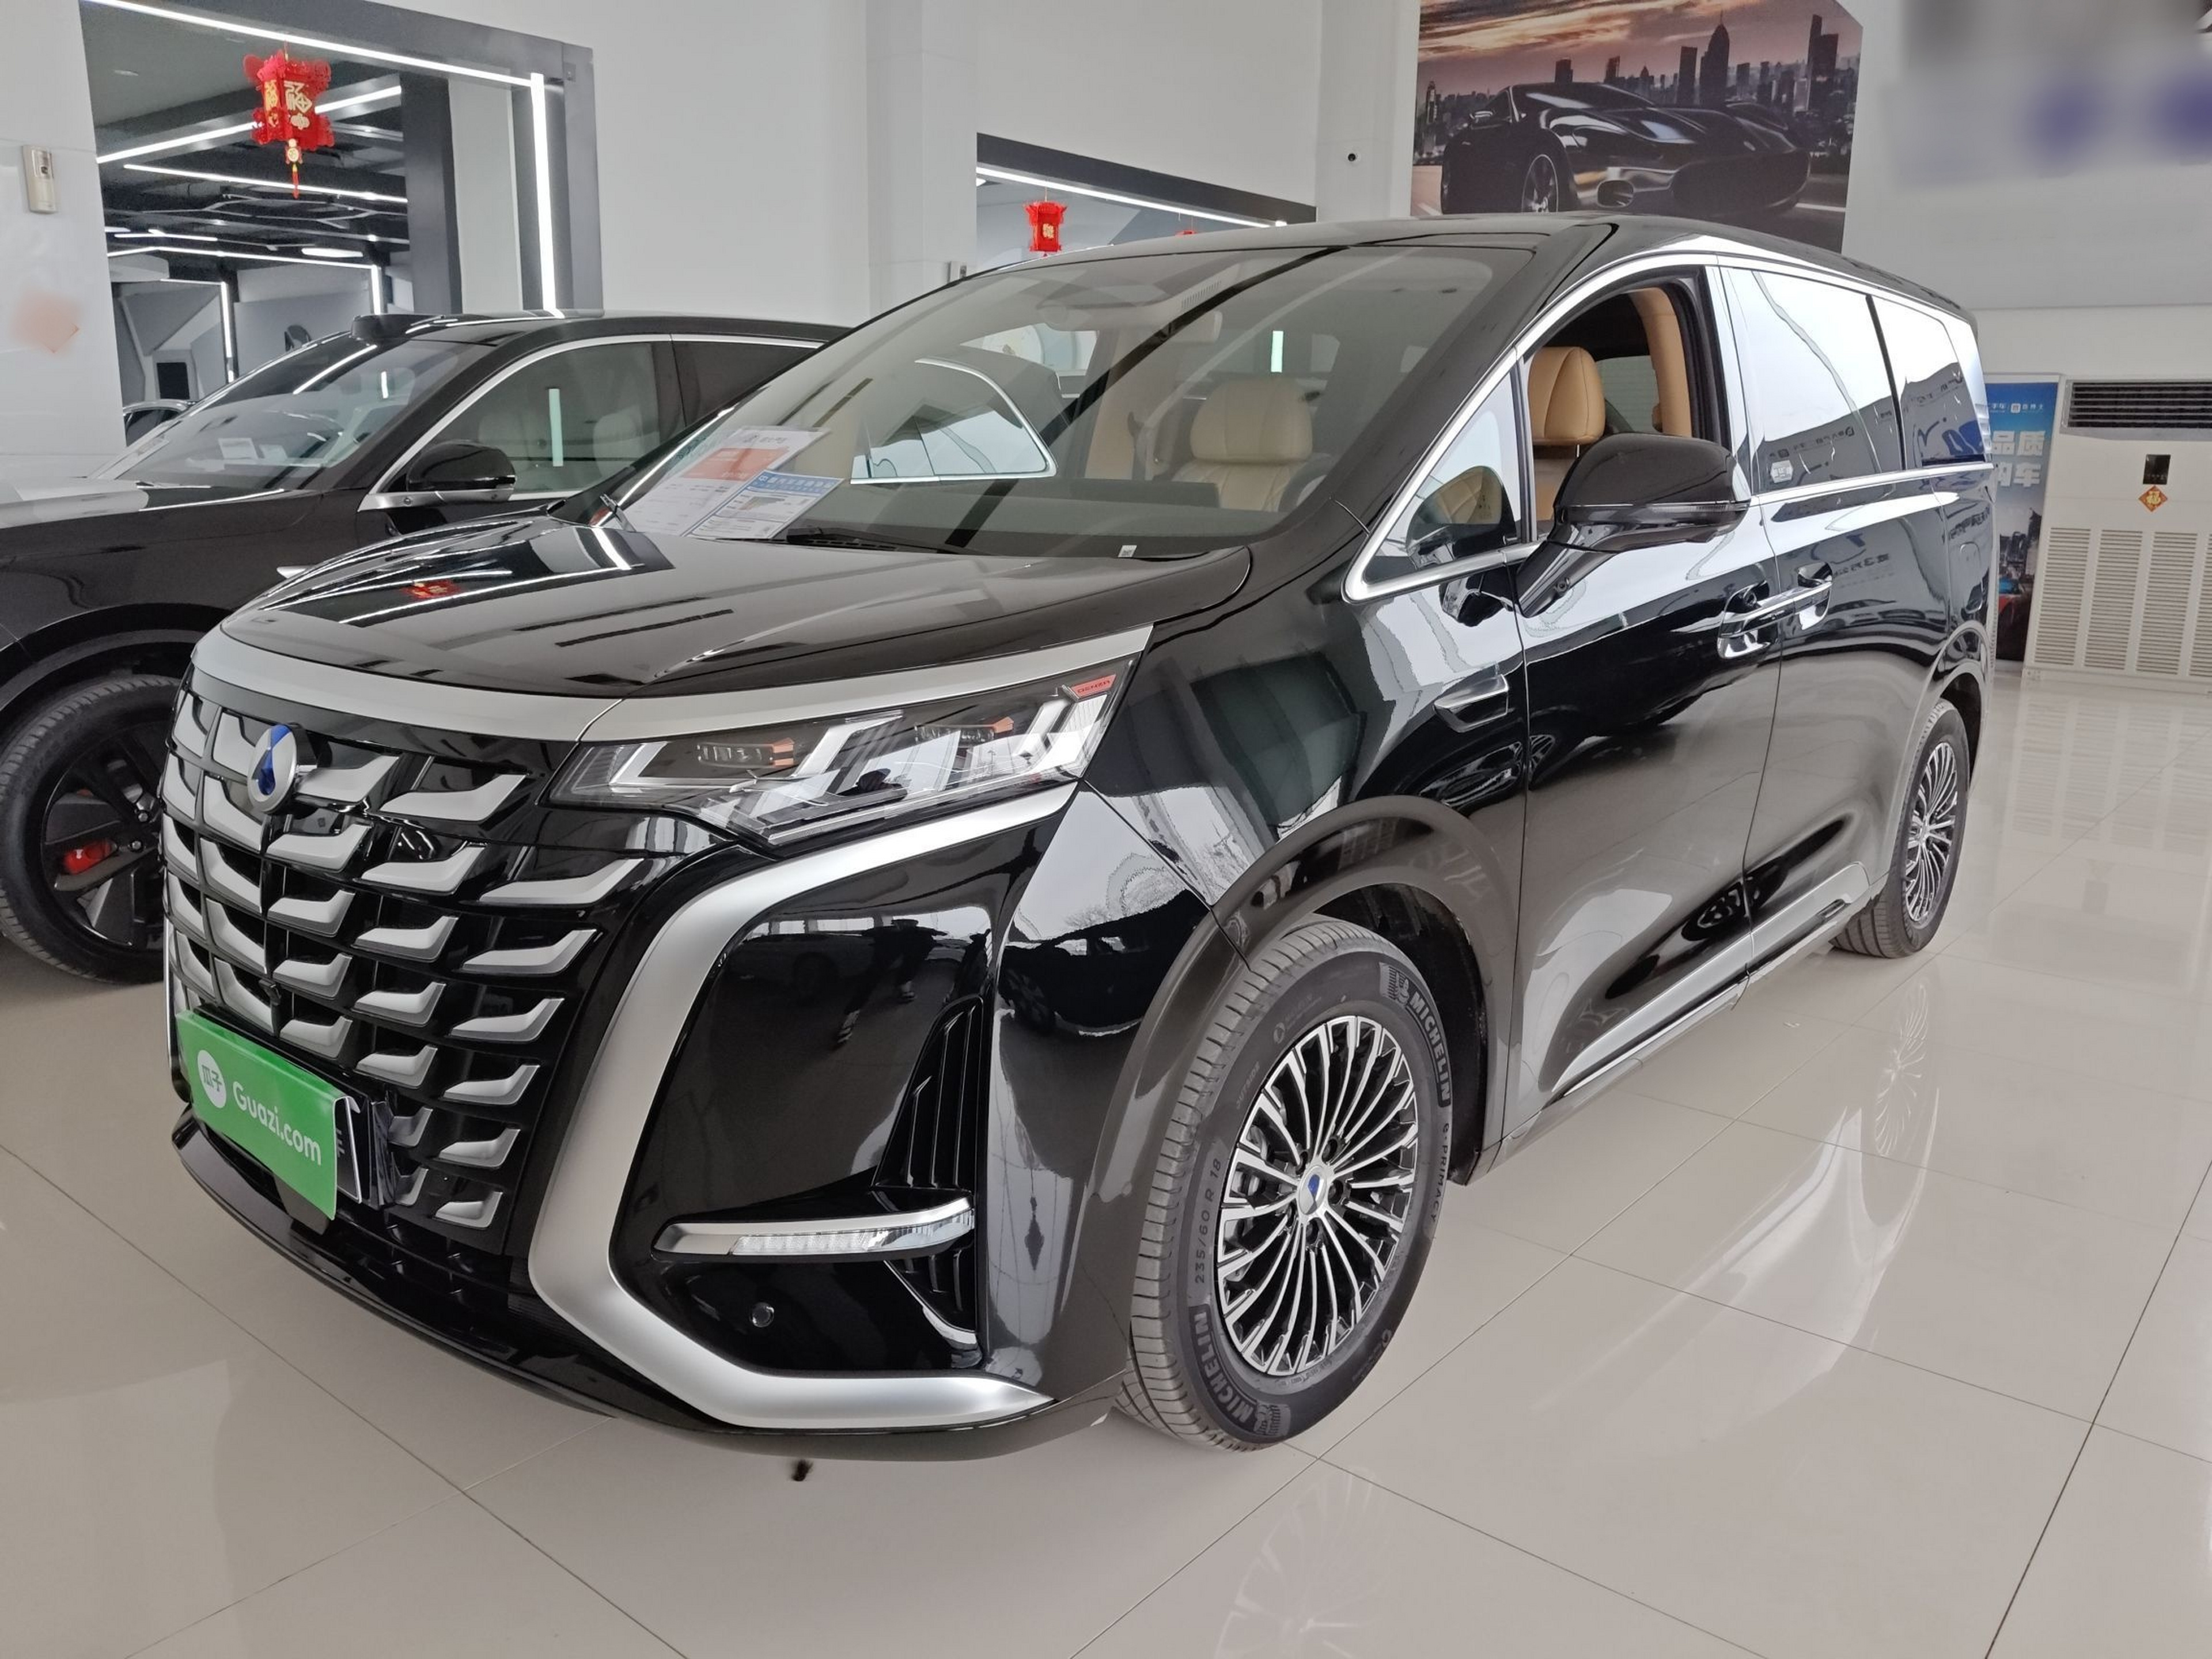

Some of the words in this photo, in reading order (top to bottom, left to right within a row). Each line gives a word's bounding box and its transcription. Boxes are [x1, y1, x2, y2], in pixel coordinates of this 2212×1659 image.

[1993, 430, 2046, 456] 品质
[1078, 680, 1110, 693] DENZA
[202, 1065, 222, 1092] 瓜子
[1410, 991, 1450, 1101] MICHELIN
[233, 1081, 321, 1166] Guazi.com
[1195, 1210, 1210, 1284] 235/60
[1205, 1188, 1214, 1202] R
[1210, 1158, 1221, 1179] 18
[1194, 1312, 1255, 1423] MICHELIN
